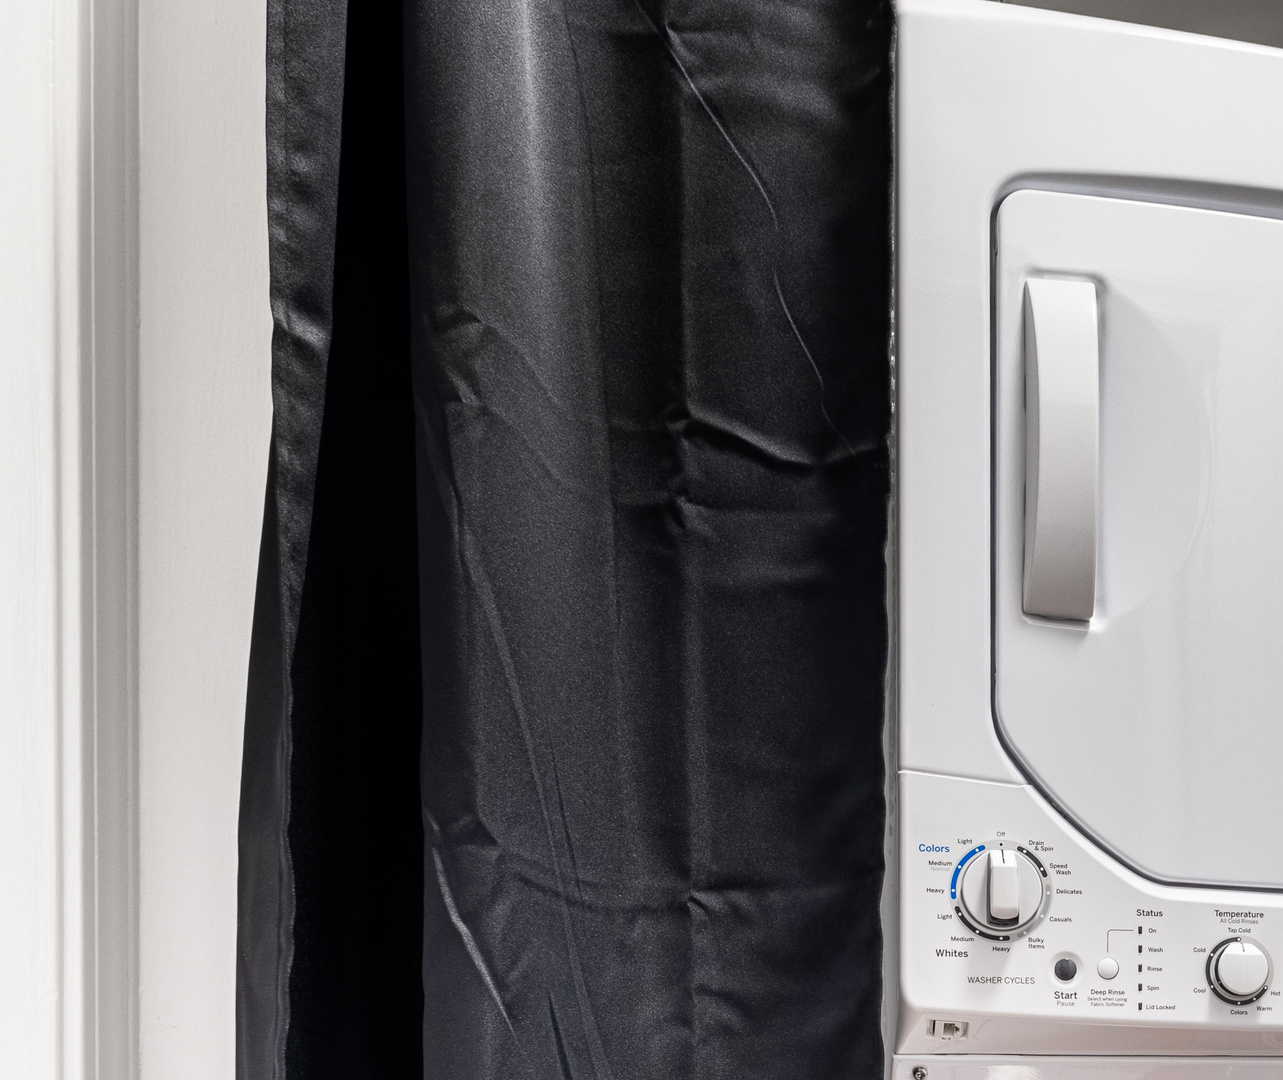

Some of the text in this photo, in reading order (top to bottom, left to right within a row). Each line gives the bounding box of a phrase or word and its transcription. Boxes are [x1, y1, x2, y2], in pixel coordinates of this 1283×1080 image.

[918, 844, 950, 853] Colors
[1136, 909, 1163, 917] Status
[1215, 910, 1264, 919] Temperature
[935, 949, 968, 958] Whites
[992, 945, 1010, 953] Heavy
[1054, 991, 1078, 1000] Start
